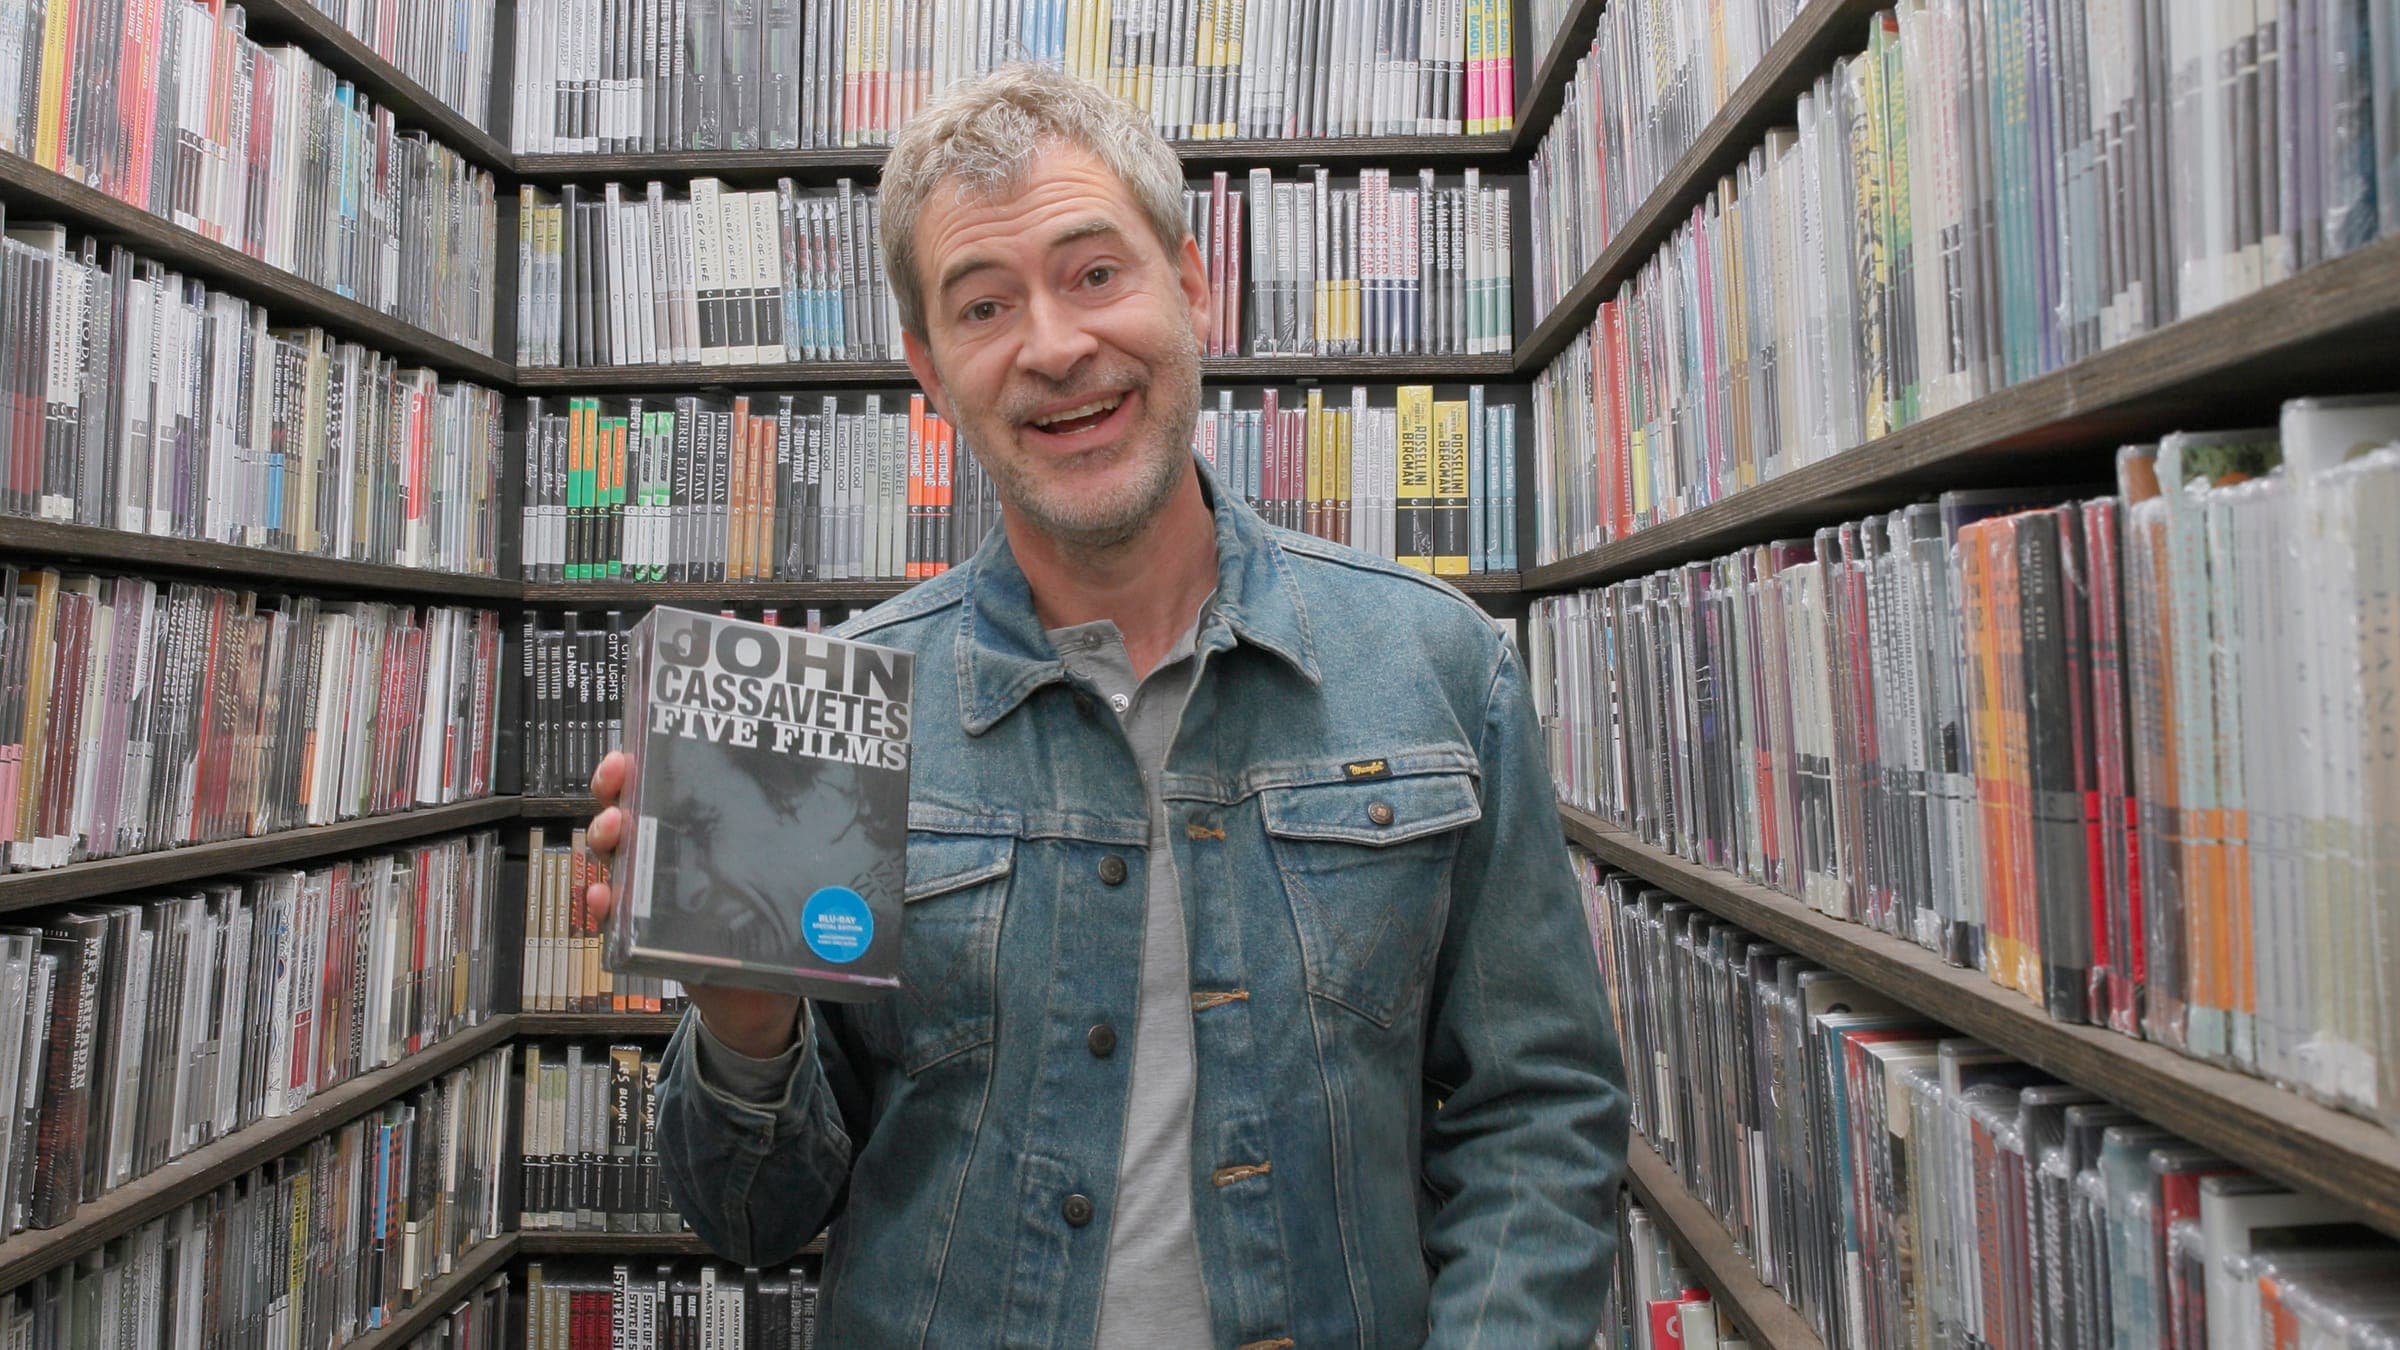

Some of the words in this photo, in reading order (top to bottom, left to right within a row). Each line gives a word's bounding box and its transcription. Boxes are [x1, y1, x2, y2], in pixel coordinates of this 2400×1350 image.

[660, 21, 670, 43] WAR
[1470, 15, 1479, 56] RAOUL
[1486, 20, 1494, 54] RAOUL
[1500, 19, 1508, 53] RAOUL
[660, 47, 670, 77] ROOM
[694, 189, 705, 235] TRILOGY
[699, 240, 707, 253] OF
[1256, 206, 1267, 255] WATERFRONT
[1278, 221, 1289, 272] WATERFRONT
[1422, 224, 1434, 264] ESCAPED
[728, 244, 735, 256] OF
[757, 243, 764, 255] OF
[1436, 231, 1448, 270] ESCAPED
[1452, 231, 1464, 270] ESCAPED
[701, 257, 709, 283] LIFE
[729, 260, 737, 280] LIFE
[83, 254, 94, 341] UMBERTO
[630, 406, 641, 428] REPO
[677, 409, 689, 453] PIERRE
[823, 406, 832, 446] medium
[868, 405, 877, 424] LIFE
[697, 415, 709, 459] PIERRE
[716, 414, 729, 459] PIERRE
[778, 435, 790, 464] YUMA
[838, 426, 847, 467] medium
[853, 423, 862, 464] medium
[868, 428, 876, 439] IS
[882, 428, 891, 448] LIFE
[896, 426, 905, 446] LIFE
[793, 455, 804, 483] YUMA
[807, 455, 819, 485] YUMA
[823, 449, 832, 471] cool
[867, 441, 876, 474] SWEET
[881, 452, 890, 463] IS
[896, 449, 905, 461] IS
[1402, 433, 1414, 486] BERGMAN
[1414, 426, 1427, 486] ROSSELLINI
[1438, 440, 1450, 494] BERGMAN
[1451, 433, 1463, 494] ROSSELLINI
[676, 457, 687, 495] ETAIX
[694, 463, 706, 501] ETAIX
[715, 463, 726, 501] ETAIX
[838, 469, 846, 491] cool
[853, 466, 862, 488] cool
[880, 465, 890, 498] SWEET
[895, 463, 905, 497] SWEET
[168, 599, 178, 644] YOUTH
[524, 623, 533, 638] THE
[567, 646, 576, 658] La
[609, 633, 618, 659] CITY
[659, 618, 912, 704] JOHN
[162, 657, 173, 704] BEAST
[567, 660, 577, 688] Notte
[580, 662, 589, 674] La
[596, 662, 605, 674] La
[609, 664, 618, 701] LIGHTS
[580, 676, 589, 703] Notte
[596, 676, 605, 702] Notte
[655, 665, 909, 741] CASSAVETES
[223, 694, 231, 729] CITY
[652, 703, 758, 748] FIVE
[772, 721, 907, 771] FILMS
[818, 914, 856, 924] BLU-RAY
[74, 972, 86, 1047] CONFIDENTIAL
[75, 983, 95, 1089] ARKADIN
[70, 1050, 79, 1090] REPORT
[617, 1061, 630, 1082] LES
[644, 1068, 657, 1088] LES
[618, 1088, 628, 1124] BLANK:
[646, 1094, 656, 1130] BLANK:
[613, 1274, 624, 1316] STATE
[629, 1294, 638, 1327] STATE
[643, 1295, 652, 1328] STATE
[805, 1298, 814, 1316] THE
[613, 1318, 624, 1335] OF
[629, 1329, 637, 1343] OF
[643, 1330, 652, 1344] OF
